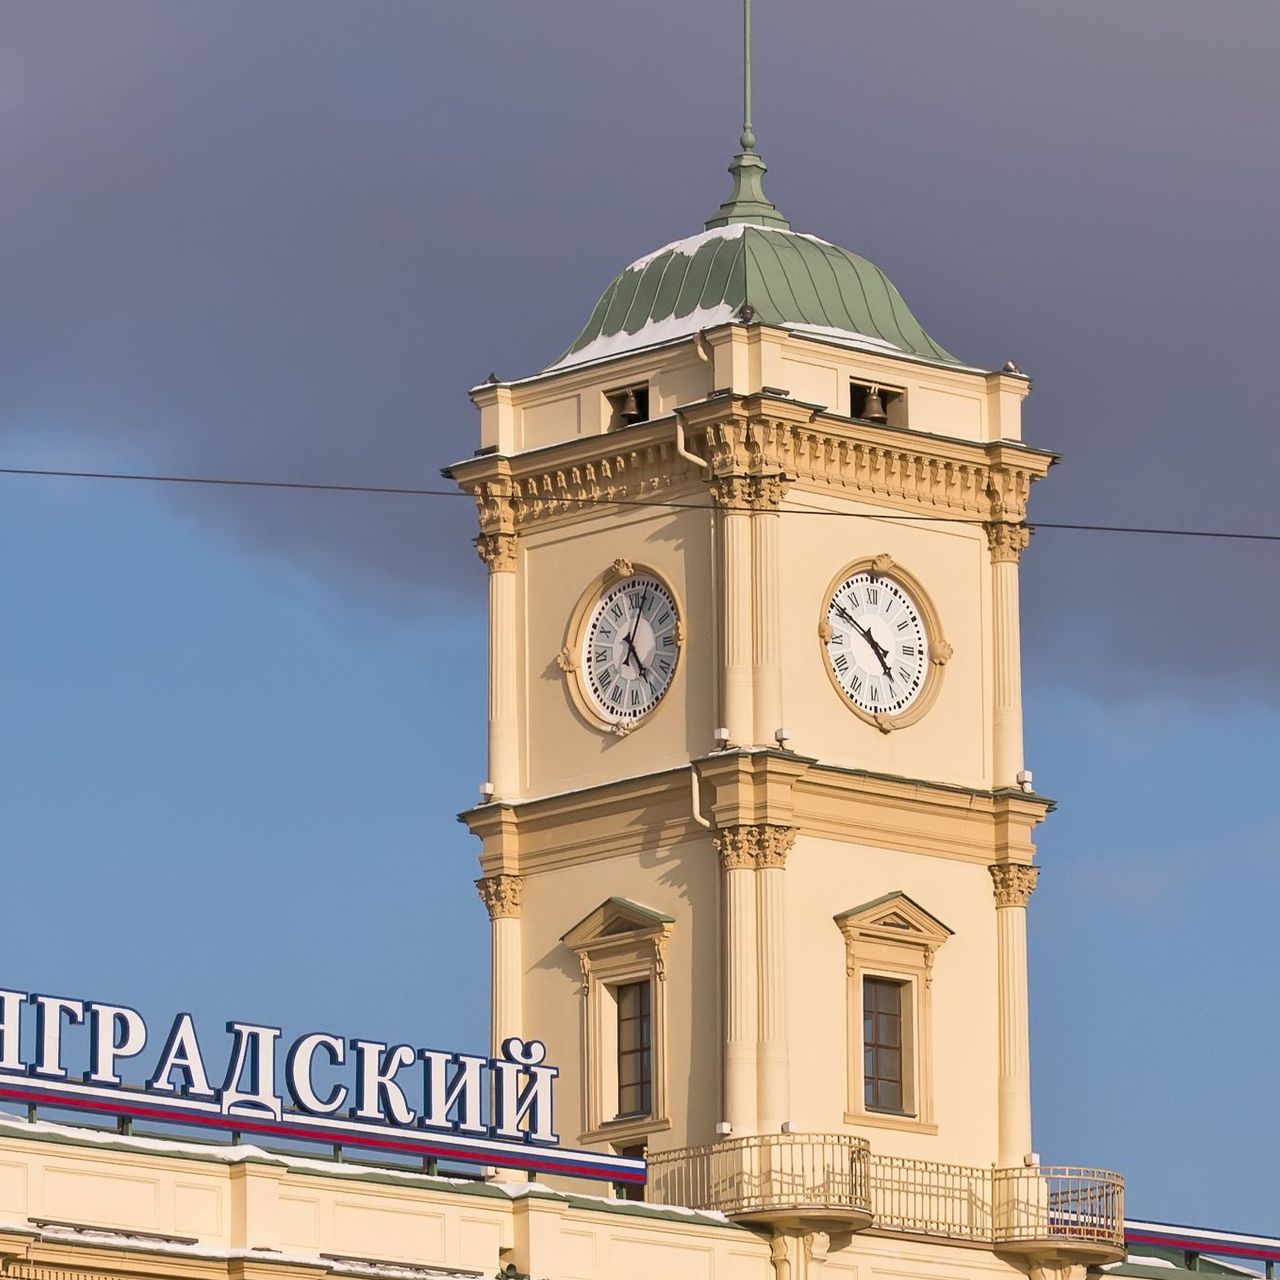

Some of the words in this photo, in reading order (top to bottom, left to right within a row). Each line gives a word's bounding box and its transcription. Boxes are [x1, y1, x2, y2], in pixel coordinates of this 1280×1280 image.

[628, 593, 641, 610] XII
[847, 592, 859, 609] XI
[866, 587, 878, 606] XII
[611, 603, 623, 622] XI
[658, 611, 670, 626] II
[896, 620, 909, 632] II
[663, 636, 675, 647] III
[595, 649, 607, 663] IX
[902, 645, 915, 656] III
[834, 655, 850, 677] VIII
[598, 669, 613, 692] VIII
[850, 674, 863, 696] VII
[611, 685, 622, 705] VII
[631, 689, 640, 706] VI
[870, 684, 880, 702] VI
